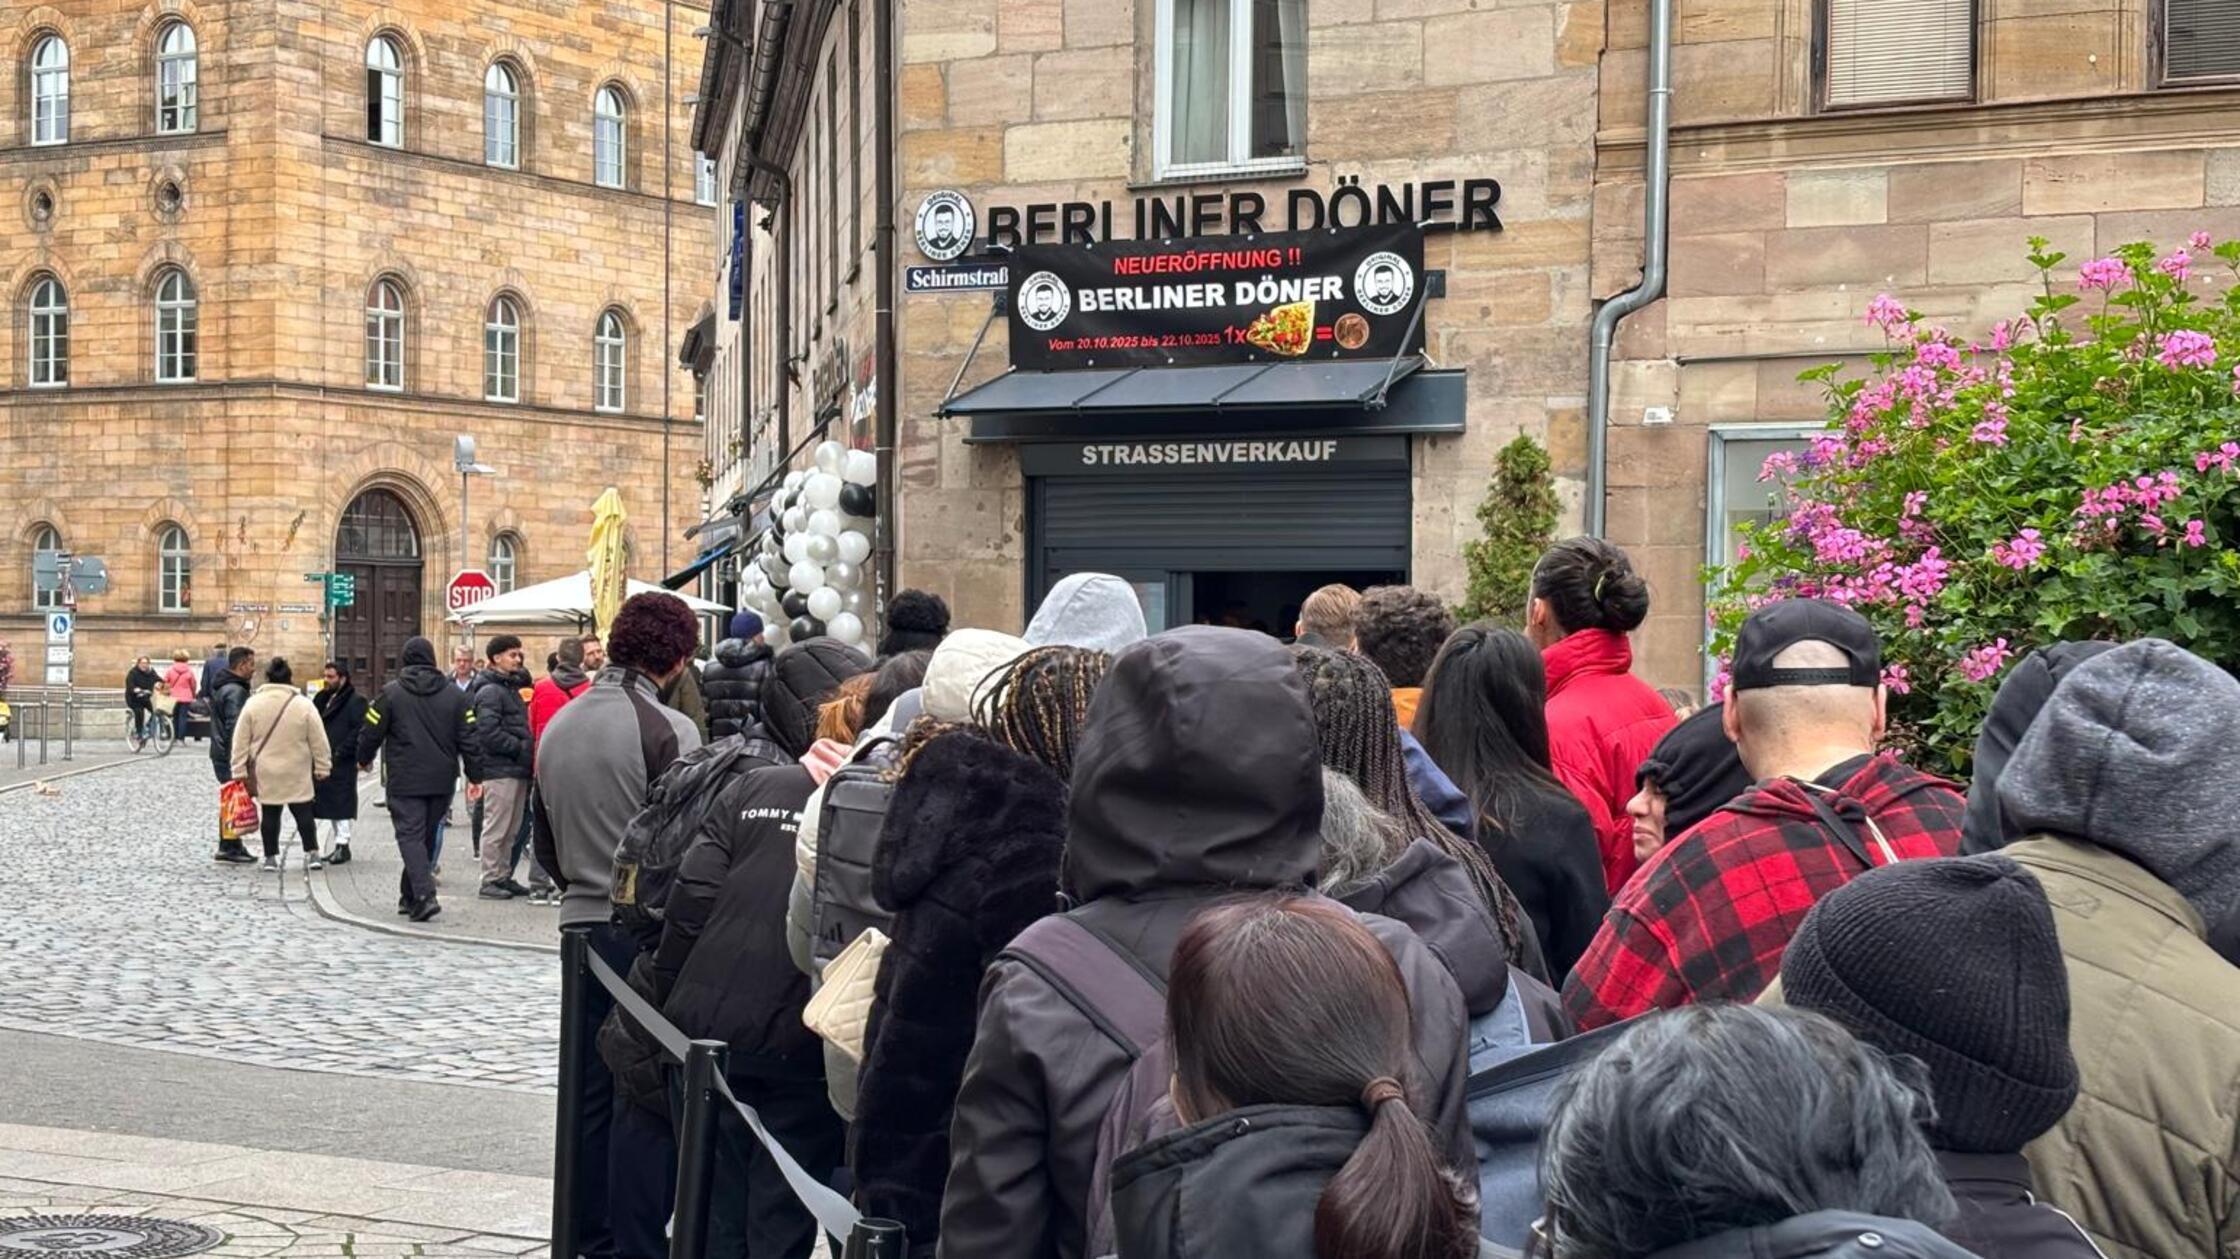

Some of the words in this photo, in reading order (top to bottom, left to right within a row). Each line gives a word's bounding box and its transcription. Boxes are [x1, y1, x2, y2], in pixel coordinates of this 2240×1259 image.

[988, 193, 1264, 247] BERLINER
[1288, 175, 1504, 232] DÖNER
[1114, 249, 1282, 275] NEUERÖFFNUNG
[1077, 283, 1227, 313] BERLINER
[1235, 274, 1344, 305] DÖNER
[1048, 338, 1074, 351] Vom
[1077, 336, 1138, 350] 20.10.2025
[1140, 334, 1158, 348] bis
[1161, 333, 1221, 347] 22.10.2025
[1224, 325, 1247, 345] 1x
[1081, 440, 1337, 465] STRASSENVERKAUF
[451, 585, 493, 607] STOP
[741, 807, 790, 820] TOMMY
